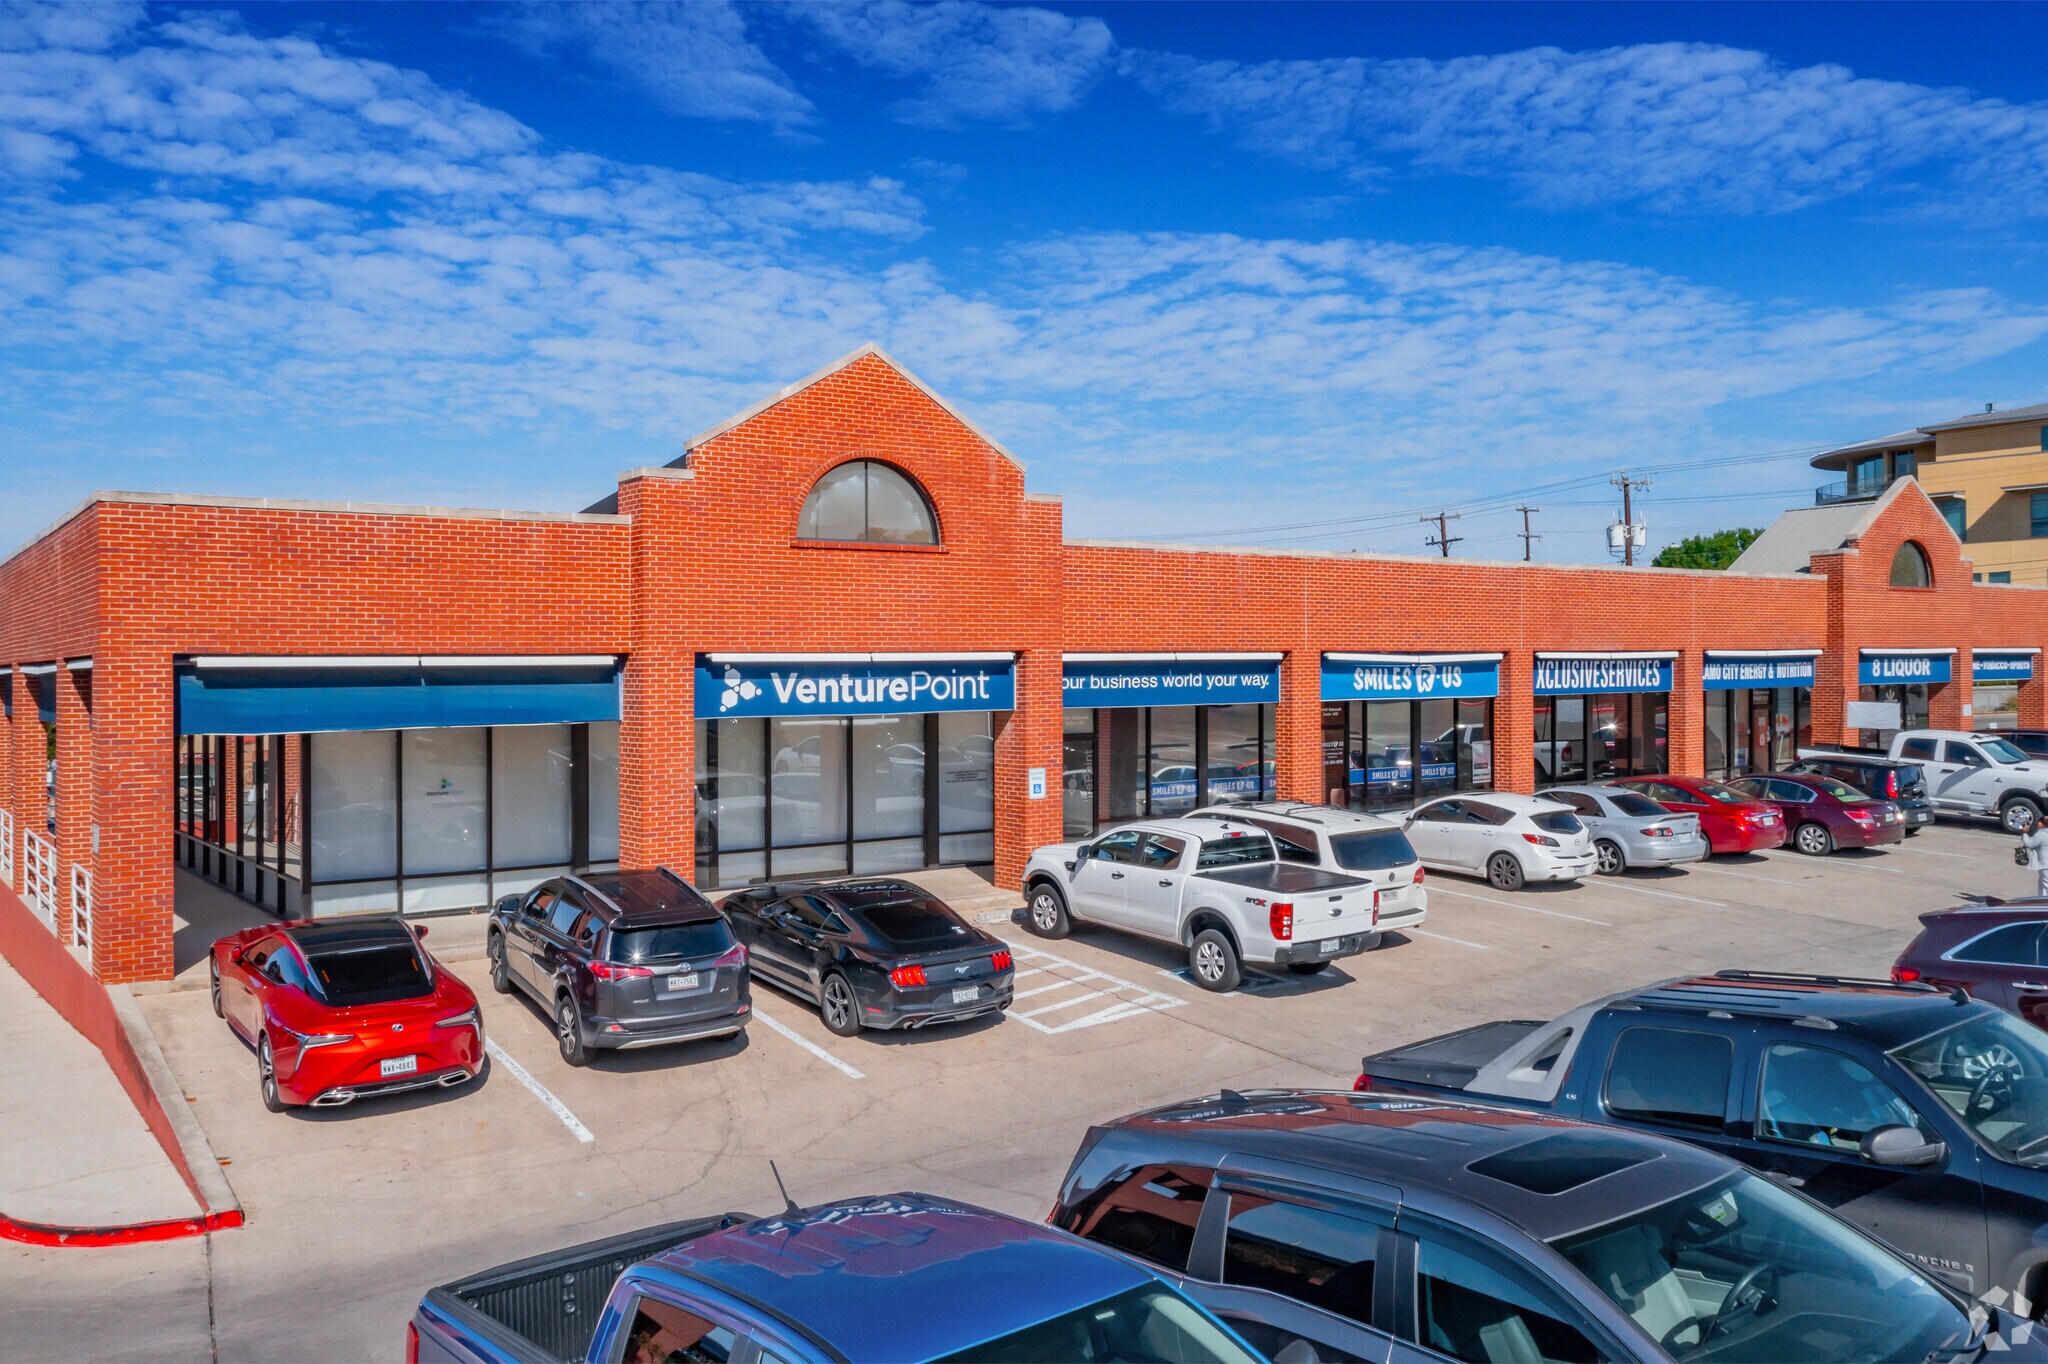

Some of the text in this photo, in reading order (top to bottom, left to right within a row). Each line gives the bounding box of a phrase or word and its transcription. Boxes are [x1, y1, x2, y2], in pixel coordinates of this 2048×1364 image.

[1536, 660, 1660, 689] XCLUSIVESERVICES
[1702, 661, 1813, 680] AMO CITY ENERGY & NUTRITION
[1872, 658, 1931, 677] 8 LIQUOR
[770, 669, 990, 704] VenturePoint
[1090, 674, 1158, 689] business
[1162, 672, 1202, 688] world
[1206, 674, 1238, 691] your
[1241, 674, 1270, 690] way.
[1353, 666, 1412, 690] SMILES
[1442, 666, 1463, 688] US
[1371, 770, 1391, 780] SMILES
[1421, 768, 1439, 777] SMILES
[1152, 785, 1176, 796] SMILES
[1213, 781, 1235, 791] SMILES
